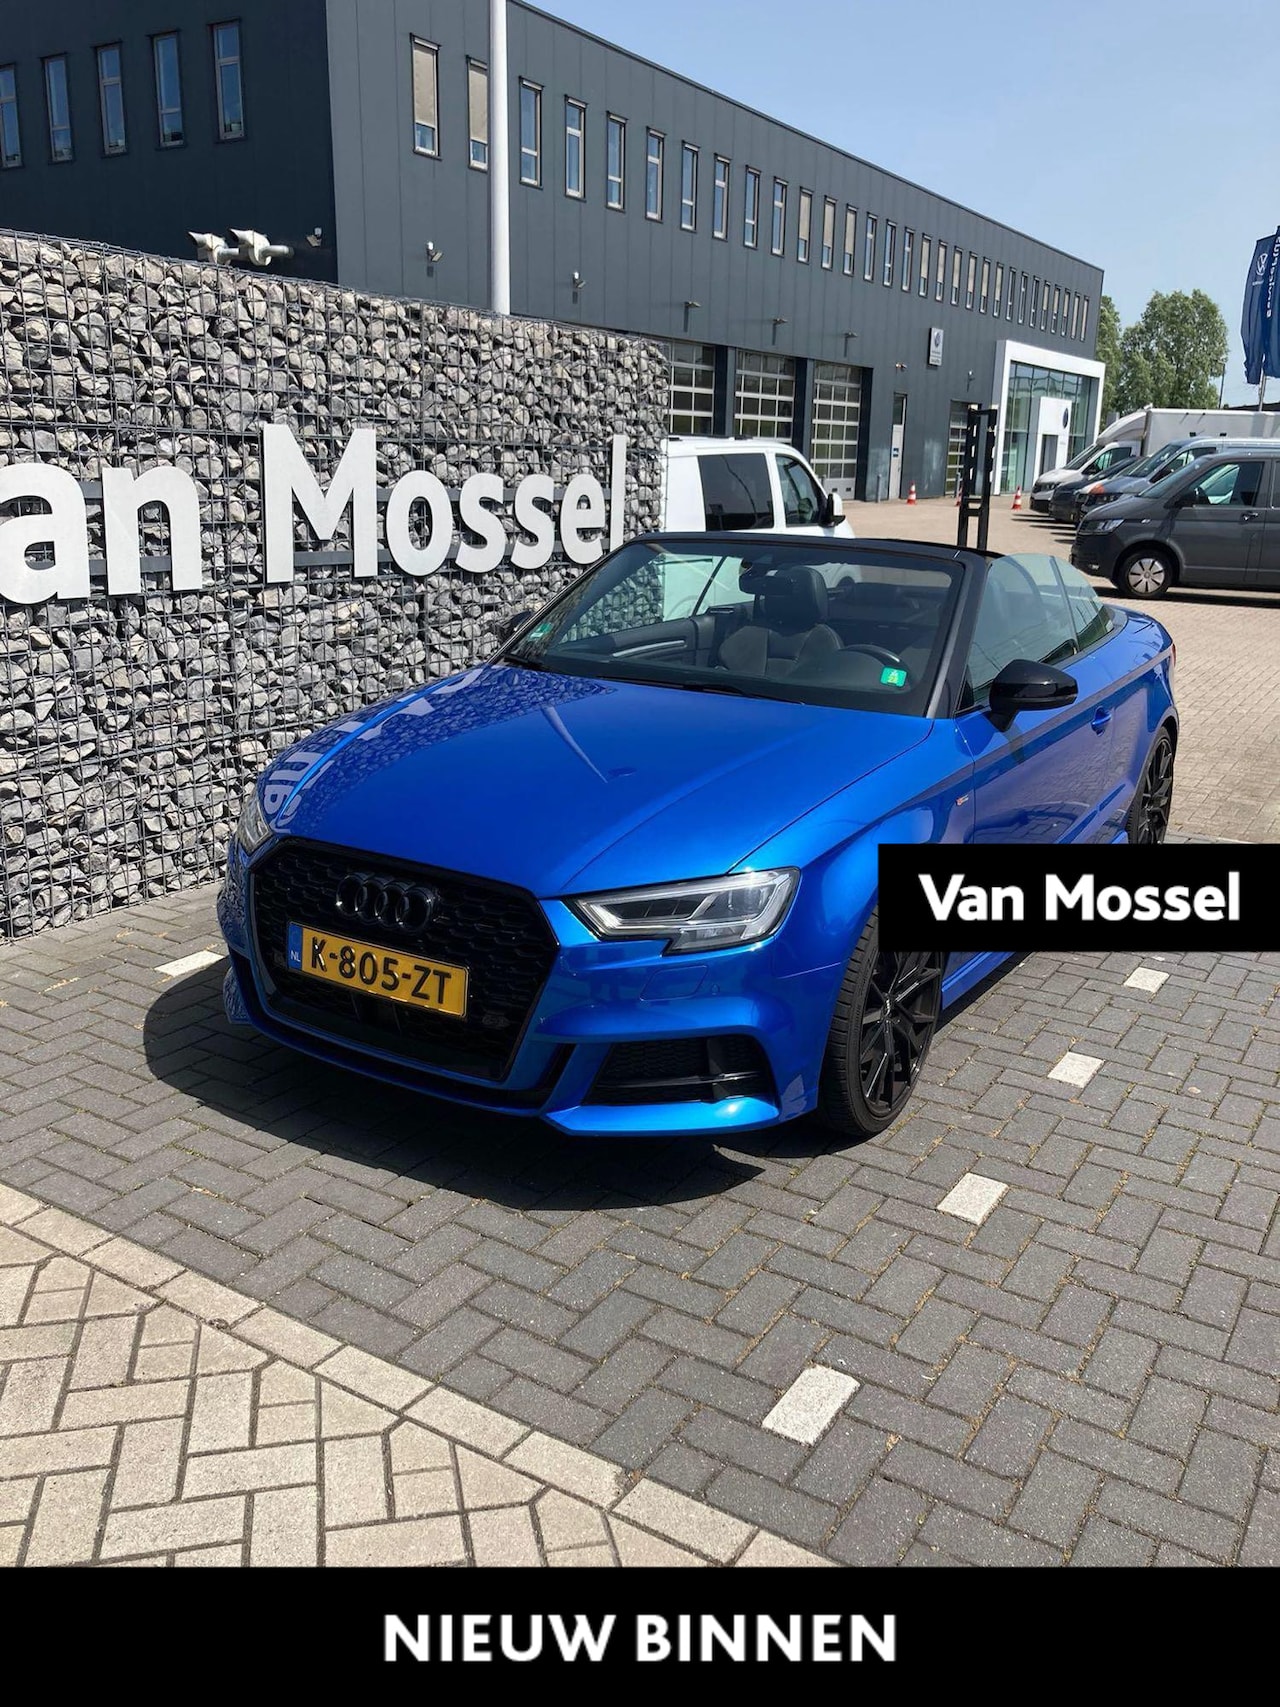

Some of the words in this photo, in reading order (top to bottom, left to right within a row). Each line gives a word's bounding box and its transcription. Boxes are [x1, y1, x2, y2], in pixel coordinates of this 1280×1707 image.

[262, 423, 627, 584] Mossel
[290, 951, 301, 962] NL
[311, 936, 452, 1005] K-805-ZT
